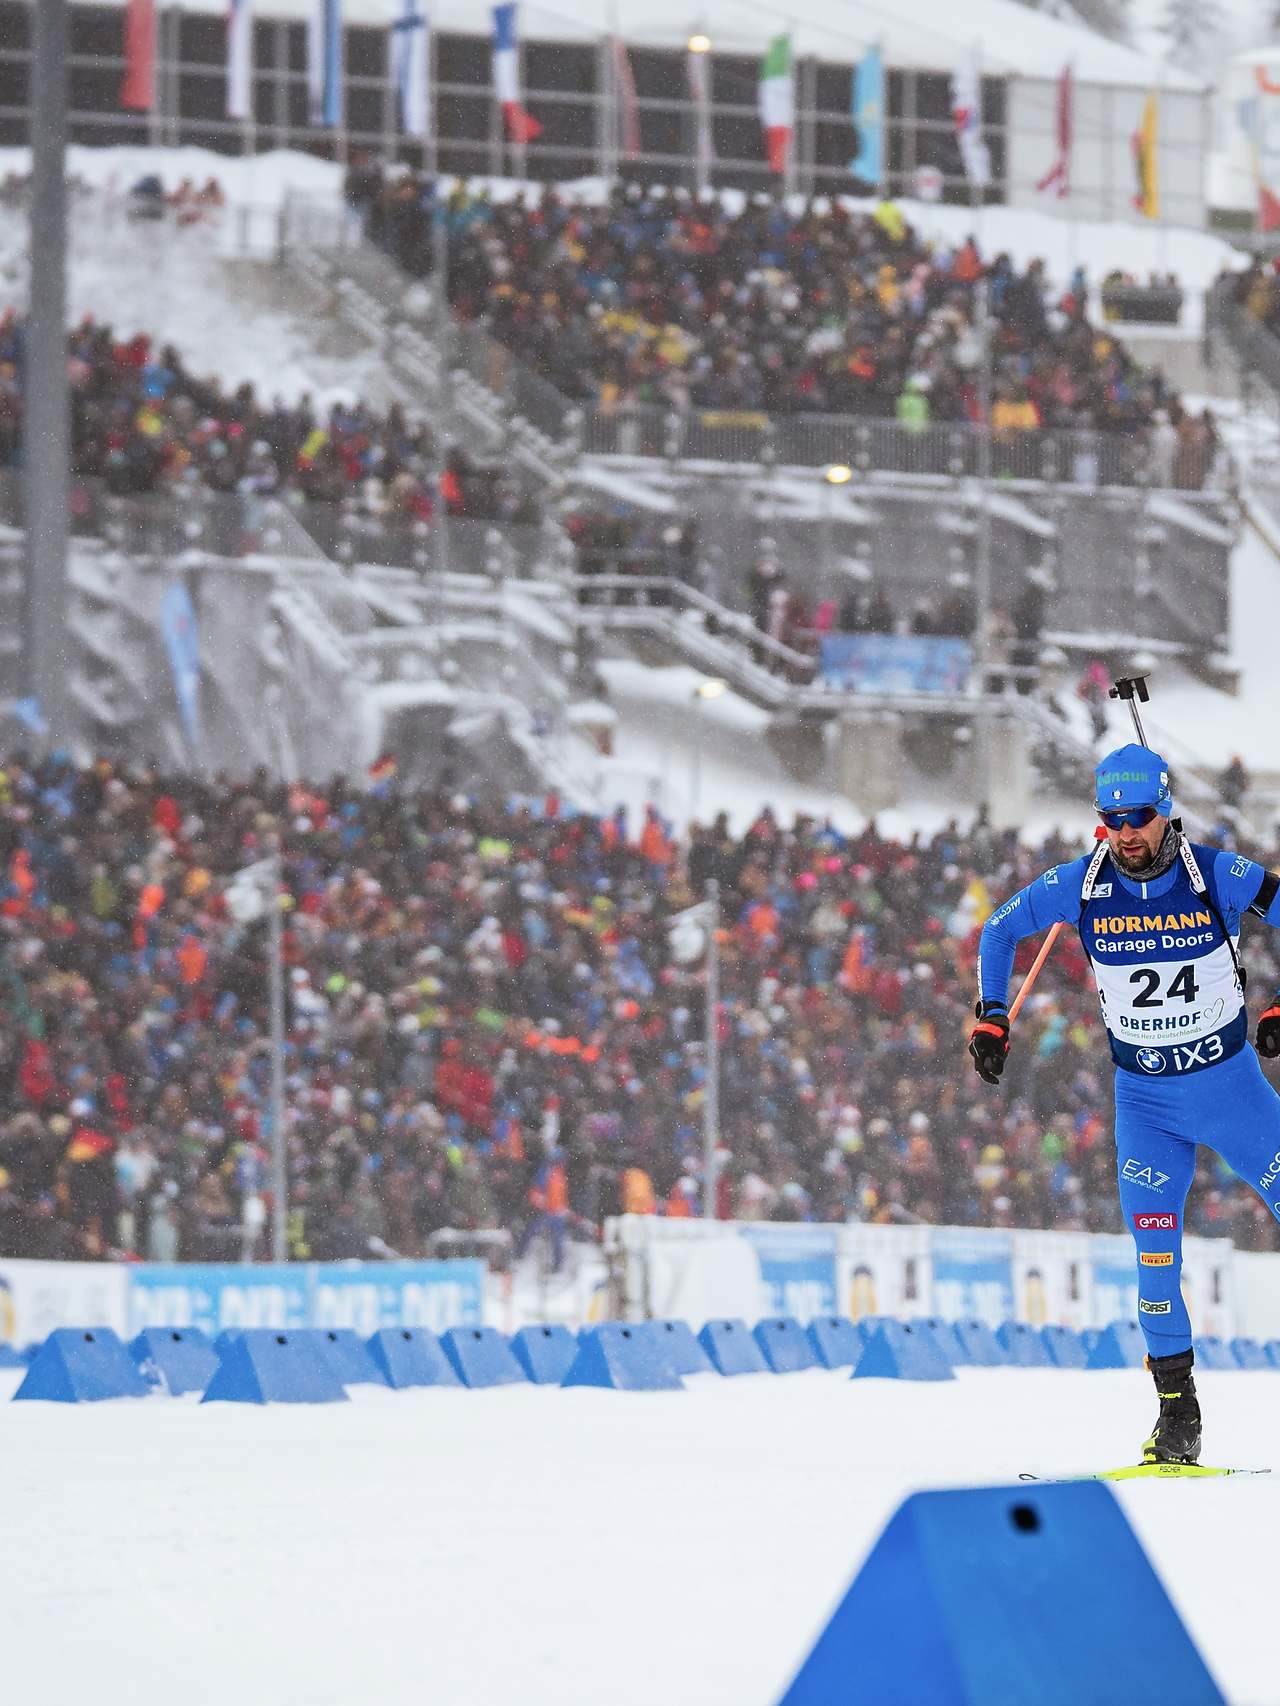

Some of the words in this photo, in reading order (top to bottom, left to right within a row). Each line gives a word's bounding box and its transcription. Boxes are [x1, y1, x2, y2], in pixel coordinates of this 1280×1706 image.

[1095, 938, 1156, 953] Garage
[1162, 932, 1214, 949] Doors
[1129, 964, 1200, 1008] 24
[1120, 1011, 1201, 1031] OBERHOF
[1172, 1034, 1224, 1070] iX3
[1139, 1215, 1174, 1228] enel
[1141, 1300, 1170, 1313] FORST
